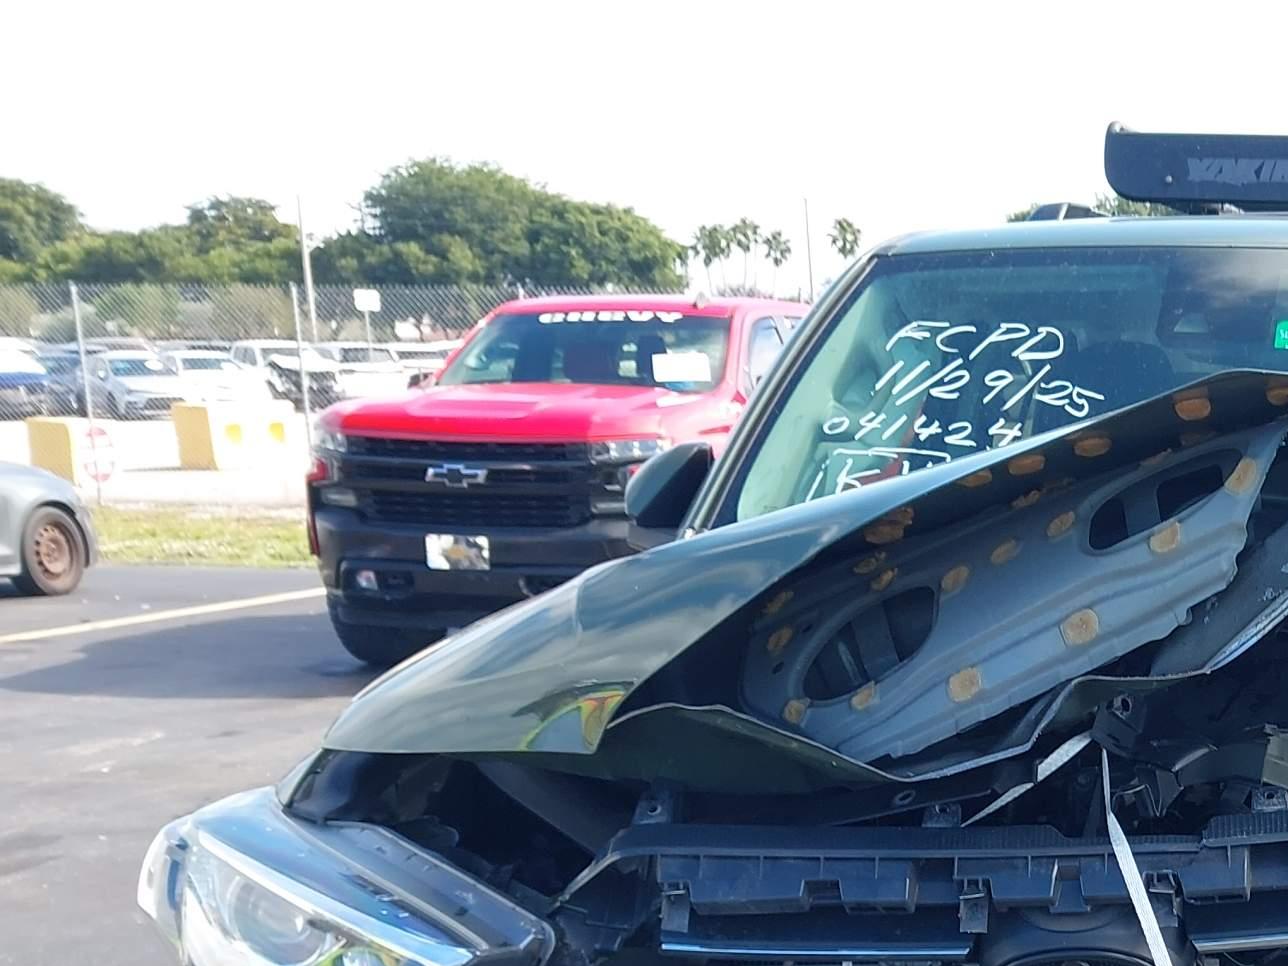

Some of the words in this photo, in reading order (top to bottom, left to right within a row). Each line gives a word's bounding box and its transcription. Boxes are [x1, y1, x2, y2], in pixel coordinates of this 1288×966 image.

[538, 309, 684, 324] CHEVY
[886, 320, 1064, 360] FCPD
[870, 359, 1105, 417] 11/29/25
